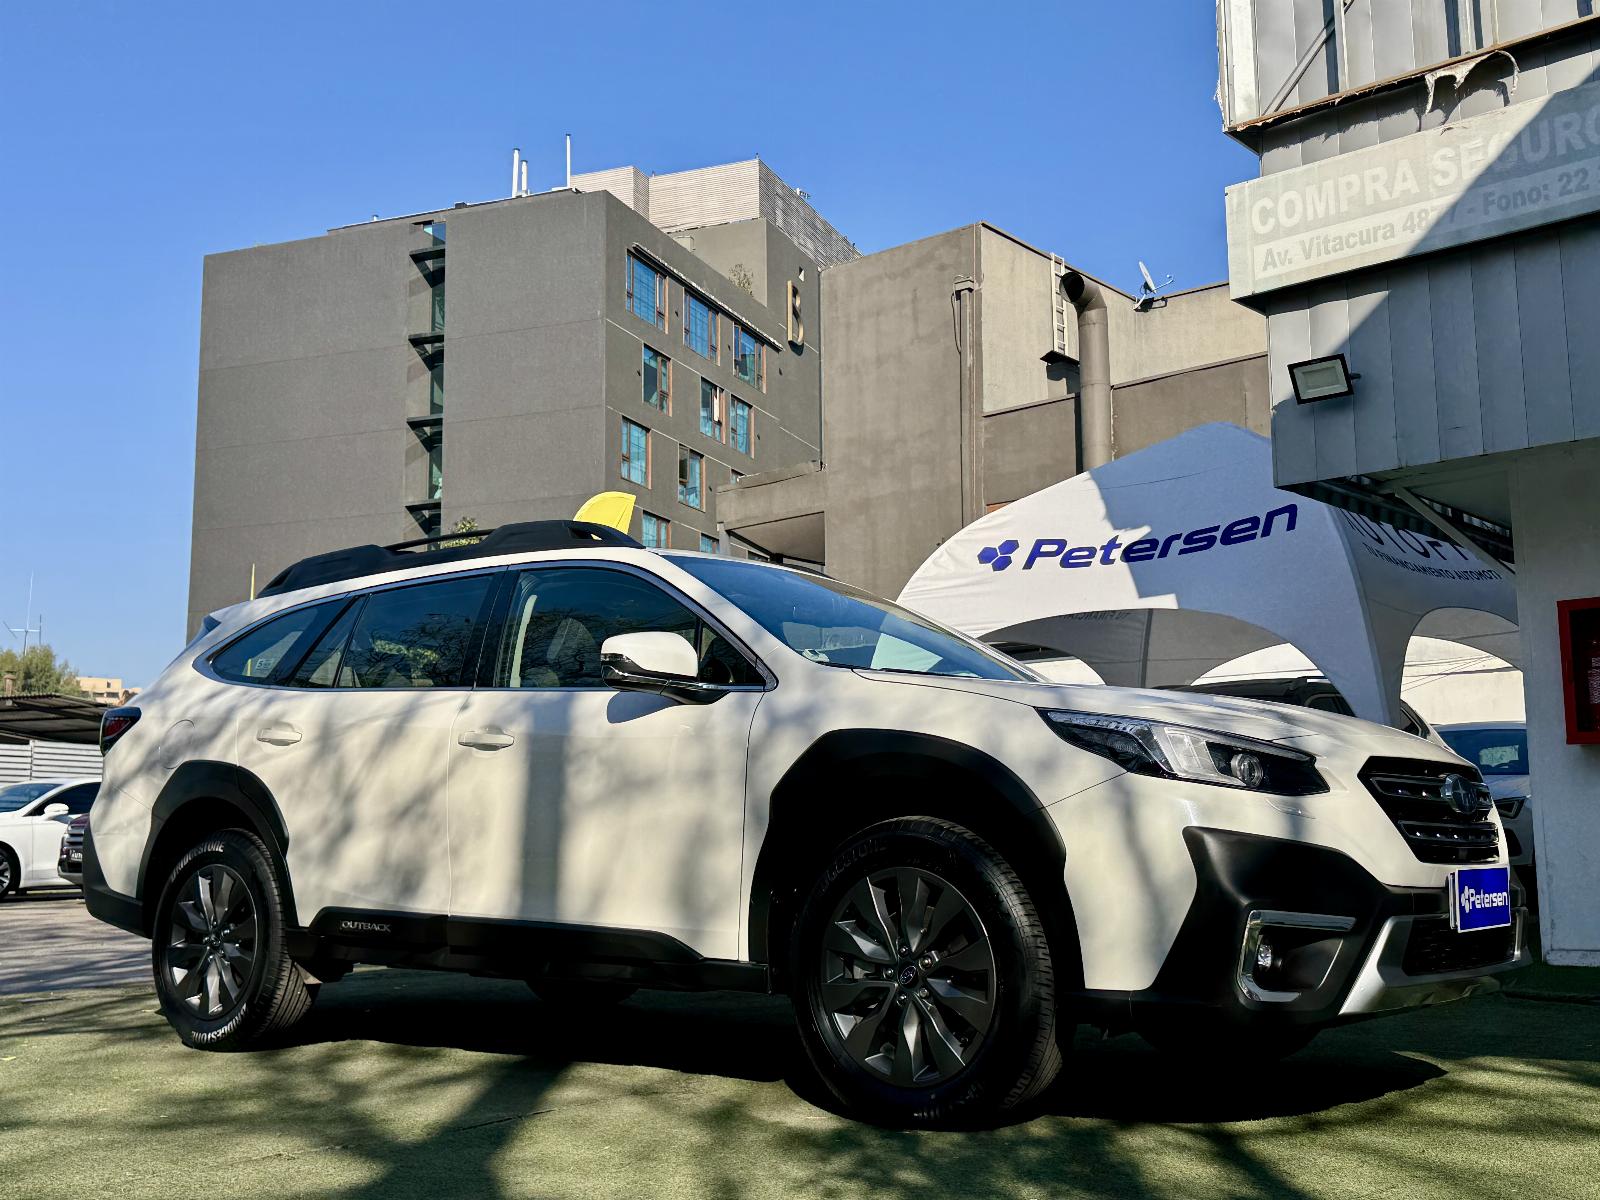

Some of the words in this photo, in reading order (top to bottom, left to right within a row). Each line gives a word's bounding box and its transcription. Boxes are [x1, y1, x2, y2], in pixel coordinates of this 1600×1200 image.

[1251, 158, 1420, 236] COMPRA
[1262, 247, 1293, 272] Av.
[1301, 221, 1395, 261] Vitacura
[1483, 183, 1550, 216] Fono:
[1557, 167, 1590, 196] 22
[1022, 503, 1298, 570] Petersen
[341, 920, 391, 933] OUTBACK
[1468, 888, 1508, 910] Petersen
